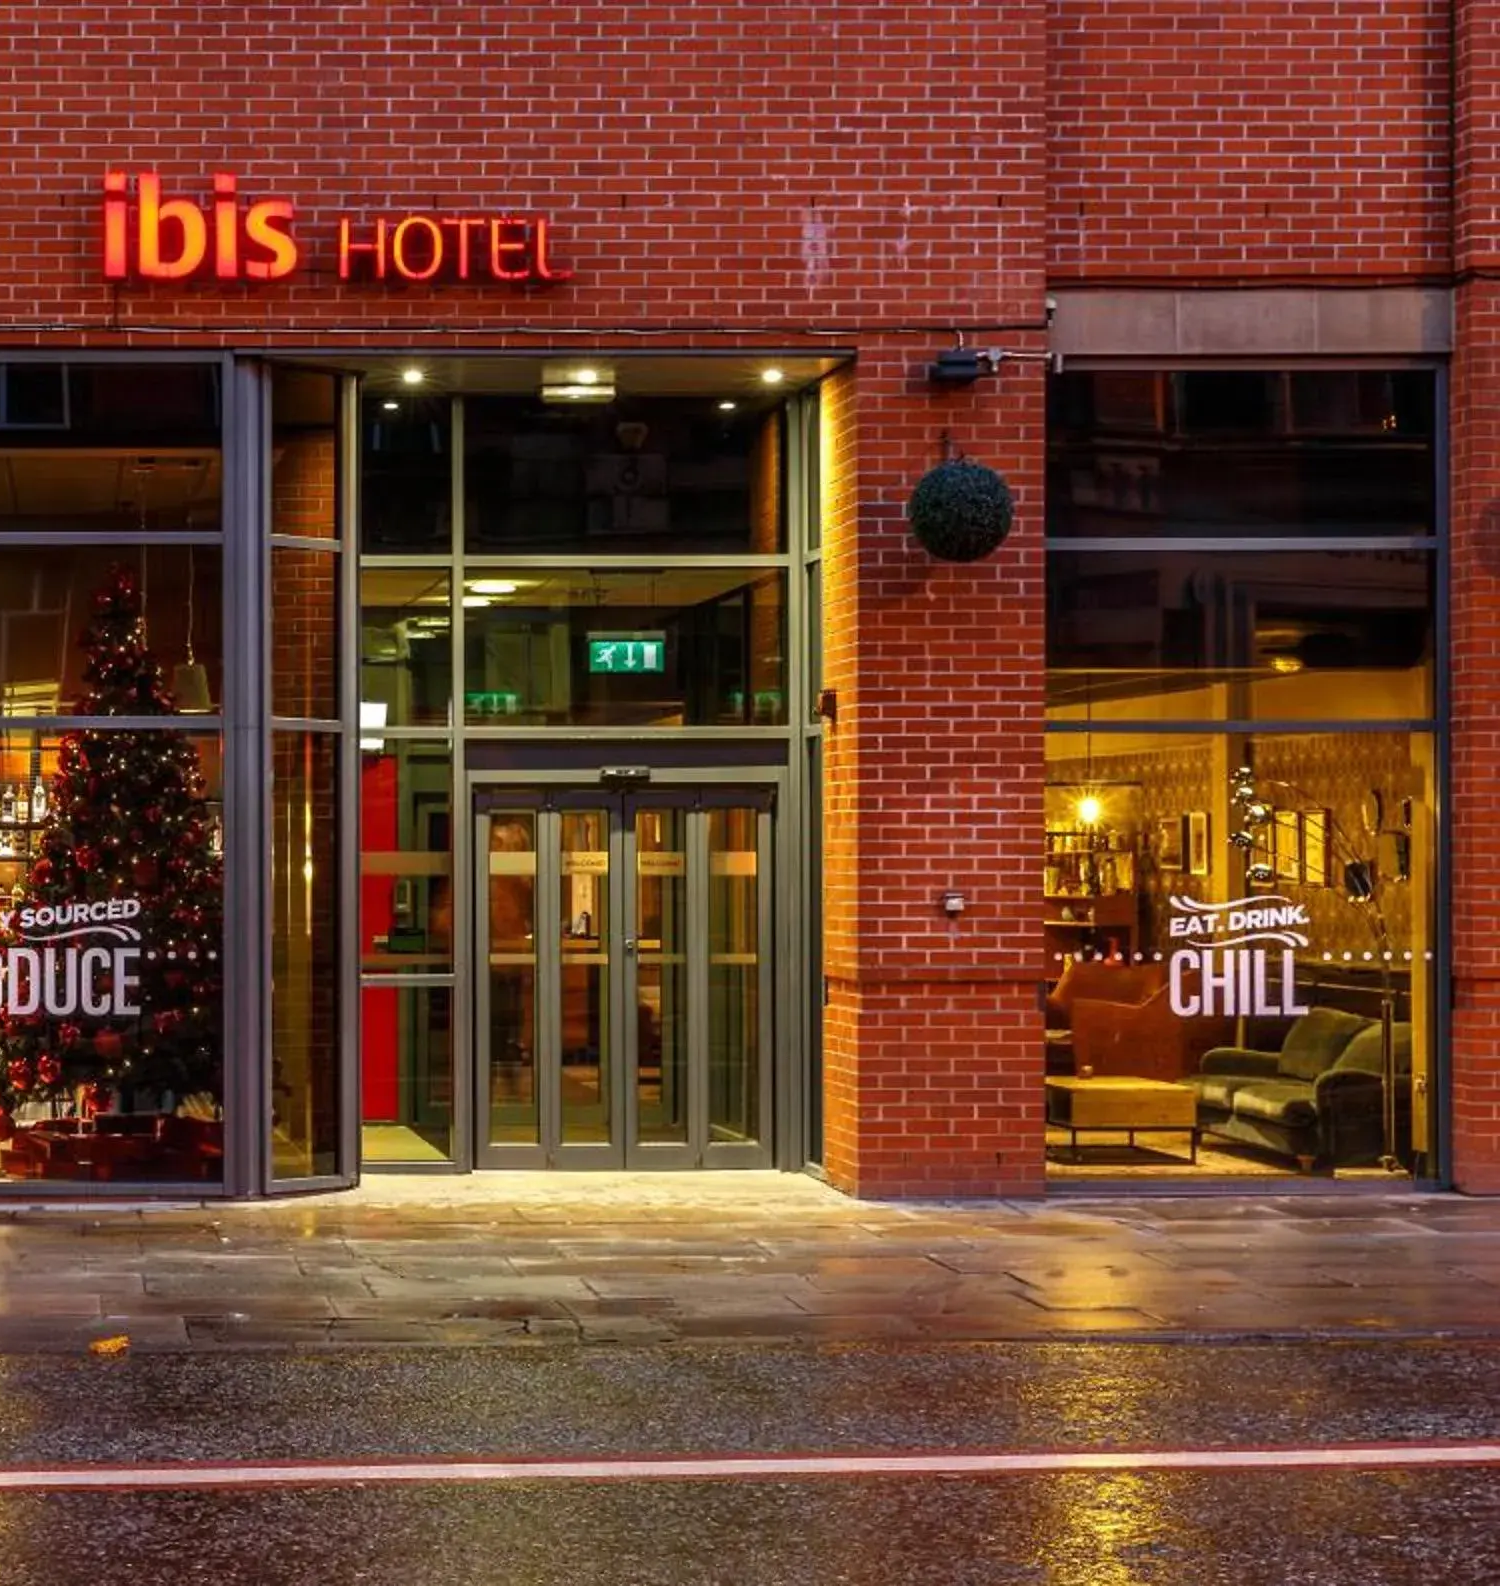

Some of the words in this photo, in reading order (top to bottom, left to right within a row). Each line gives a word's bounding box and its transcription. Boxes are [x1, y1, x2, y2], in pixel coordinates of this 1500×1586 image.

[104, 171, 298, 279] ibis
[339, 215, 574, 279] HOTEL
[19, 898, 141, 928] SOURCED
[1169, 913, 1224, 937] EAT.
[1228, 904, 1311, 931] DRINK.
[1169, 949, 1310, 1017] CHILL
